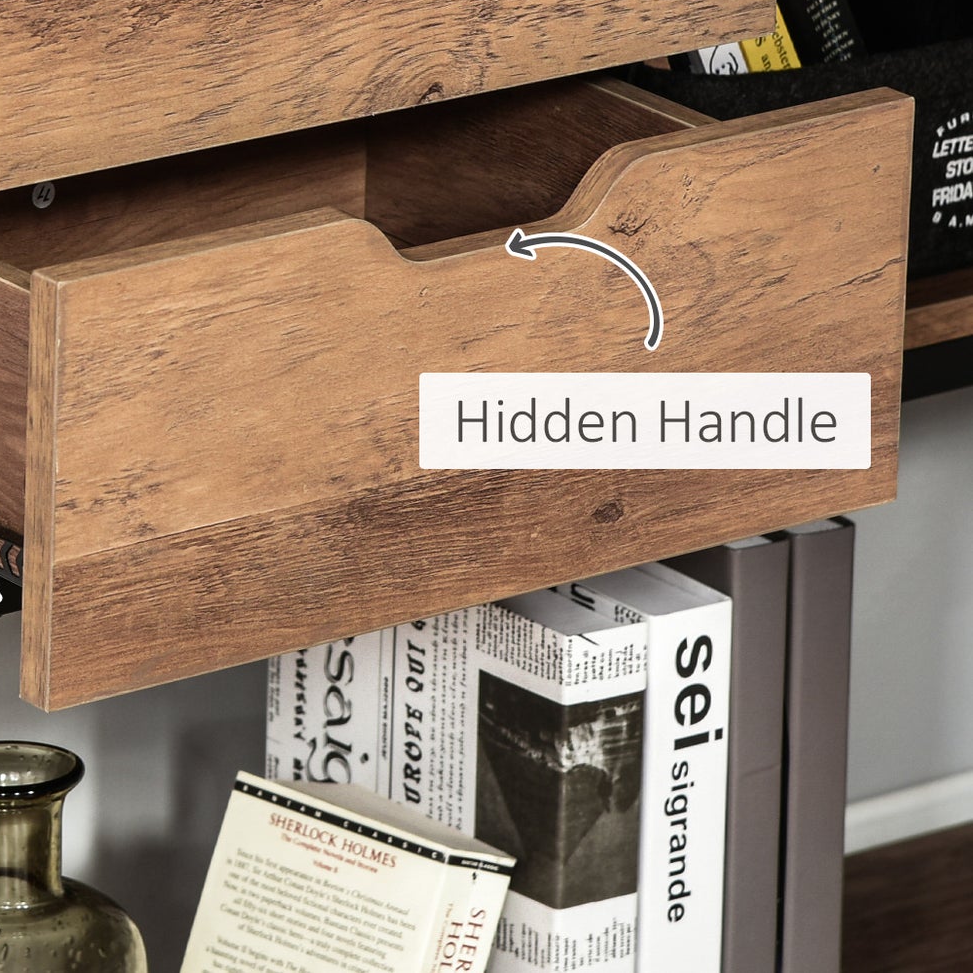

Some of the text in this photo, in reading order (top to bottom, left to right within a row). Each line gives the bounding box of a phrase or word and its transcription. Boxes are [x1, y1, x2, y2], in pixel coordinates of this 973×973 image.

[772, 30, 792, 69] ebster
[932, 134, 973, 158] LETTE
[945, 156, 973, 179] STO
[932, 181, 973, 207] FRIDA
[306, 643, 369, 785] saig
[673, 634, 723, 751] sei
[403, 703, 424, 805] UROPE
[242, 783, 439, 859] BANTAM CLASSIC
[268, 812, 398, 868] SHERLOCK HOLMES
[664, 761, 695, 924] sigrande
[454, 906, 487, 971] SHER
